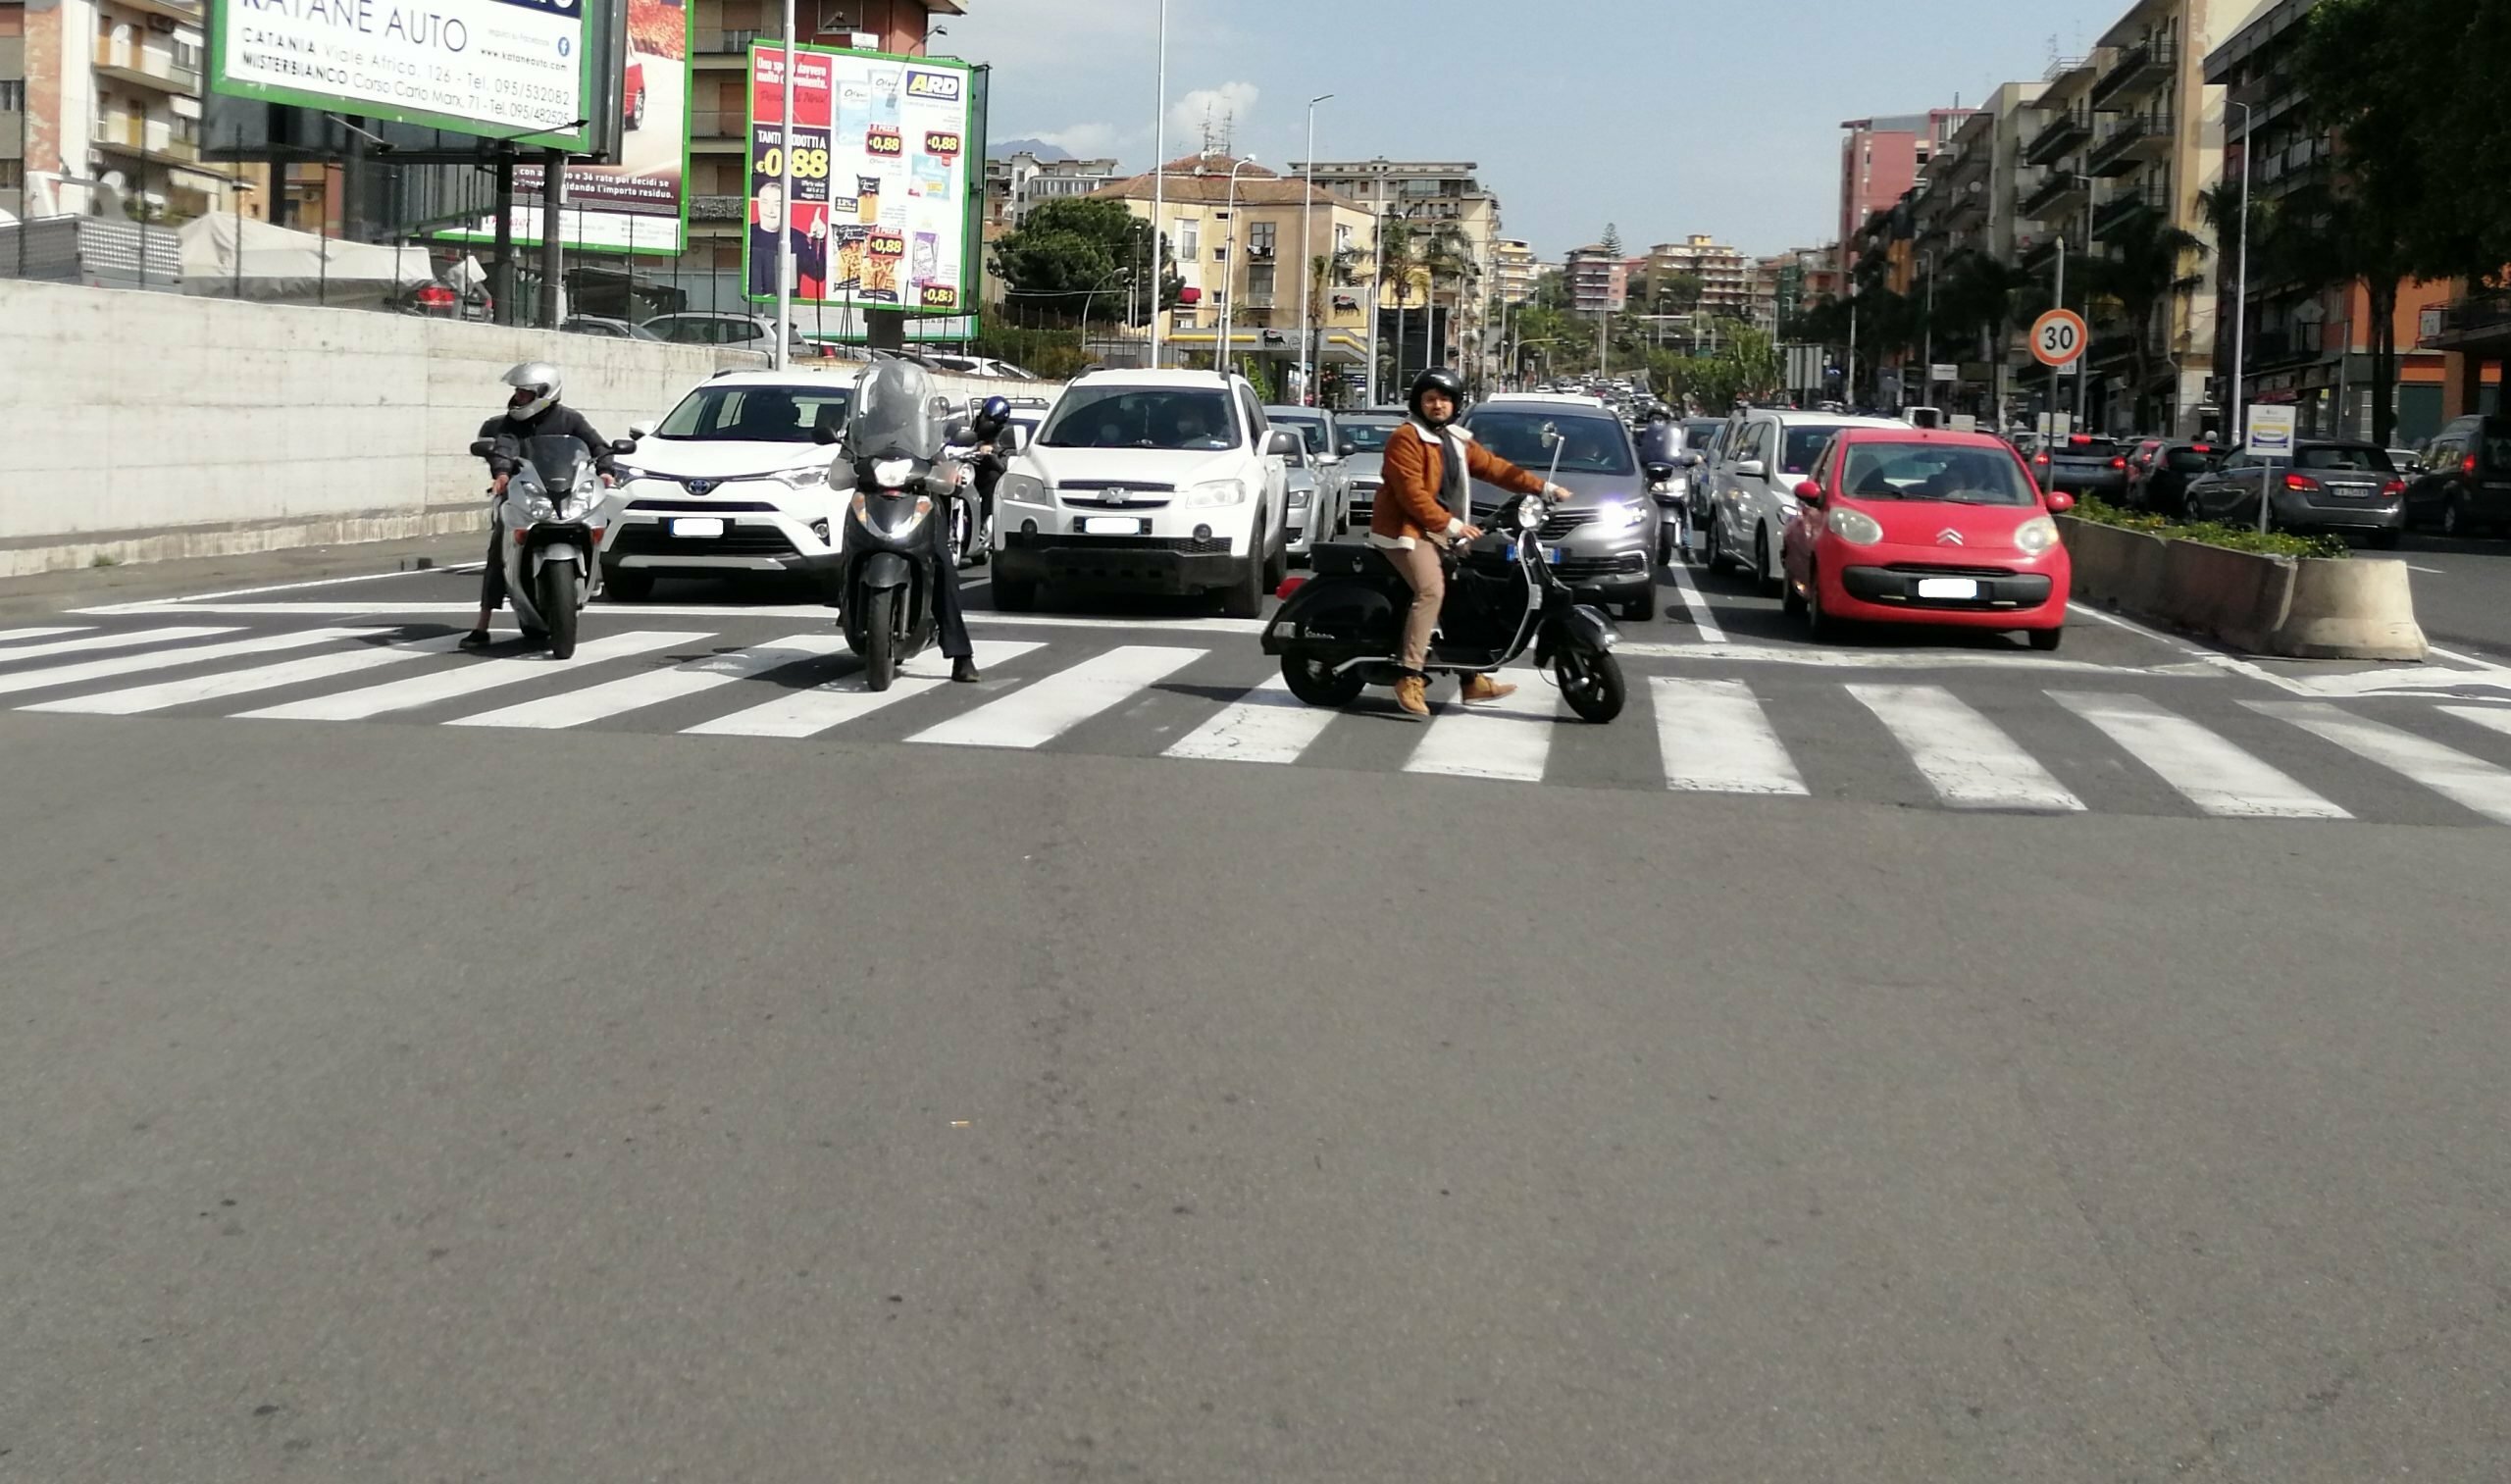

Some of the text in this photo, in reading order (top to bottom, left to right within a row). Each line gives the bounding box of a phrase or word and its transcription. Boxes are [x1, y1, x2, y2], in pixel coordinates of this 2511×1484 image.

[242, 0, 467, 52] ANE AUTO
[242, 27, 315, 53] CATANIA
[325, 43, 364, 65] Viale
[429, 64, 451, 83] 126
[467, 72, 488, 90] Tel.
[495, 78, 570, 105] 095/532082
[243, 51, 348, 84] MISTERBIANCO
[353, 73, 390, 93] Corso
[394, 80, 429, 101] Carlo
[469, 95, 480, 111] 71
[490, 99, 507, 116] Tel.
[510, 102, 569, 126] 095/482525
[780, 74, 828, 89] cveniente.
[908, 74, 958, 96] ARD
[757, 129, 827, 150] TANTI ODOTTI A
[756, 148, 829, 179] €088
[562, 181, 595, 192] aldando
[597, 183, 638, 196] l'importo
[640, 188, 674, 199] residuo.
[583, 172, 593, 180] 36
[595, 175, 614, 183] rate
[615, 175, 630, 185] poi
[632, 175, 657, 186] decidi
[2045, 326, 2074, 350] 30
